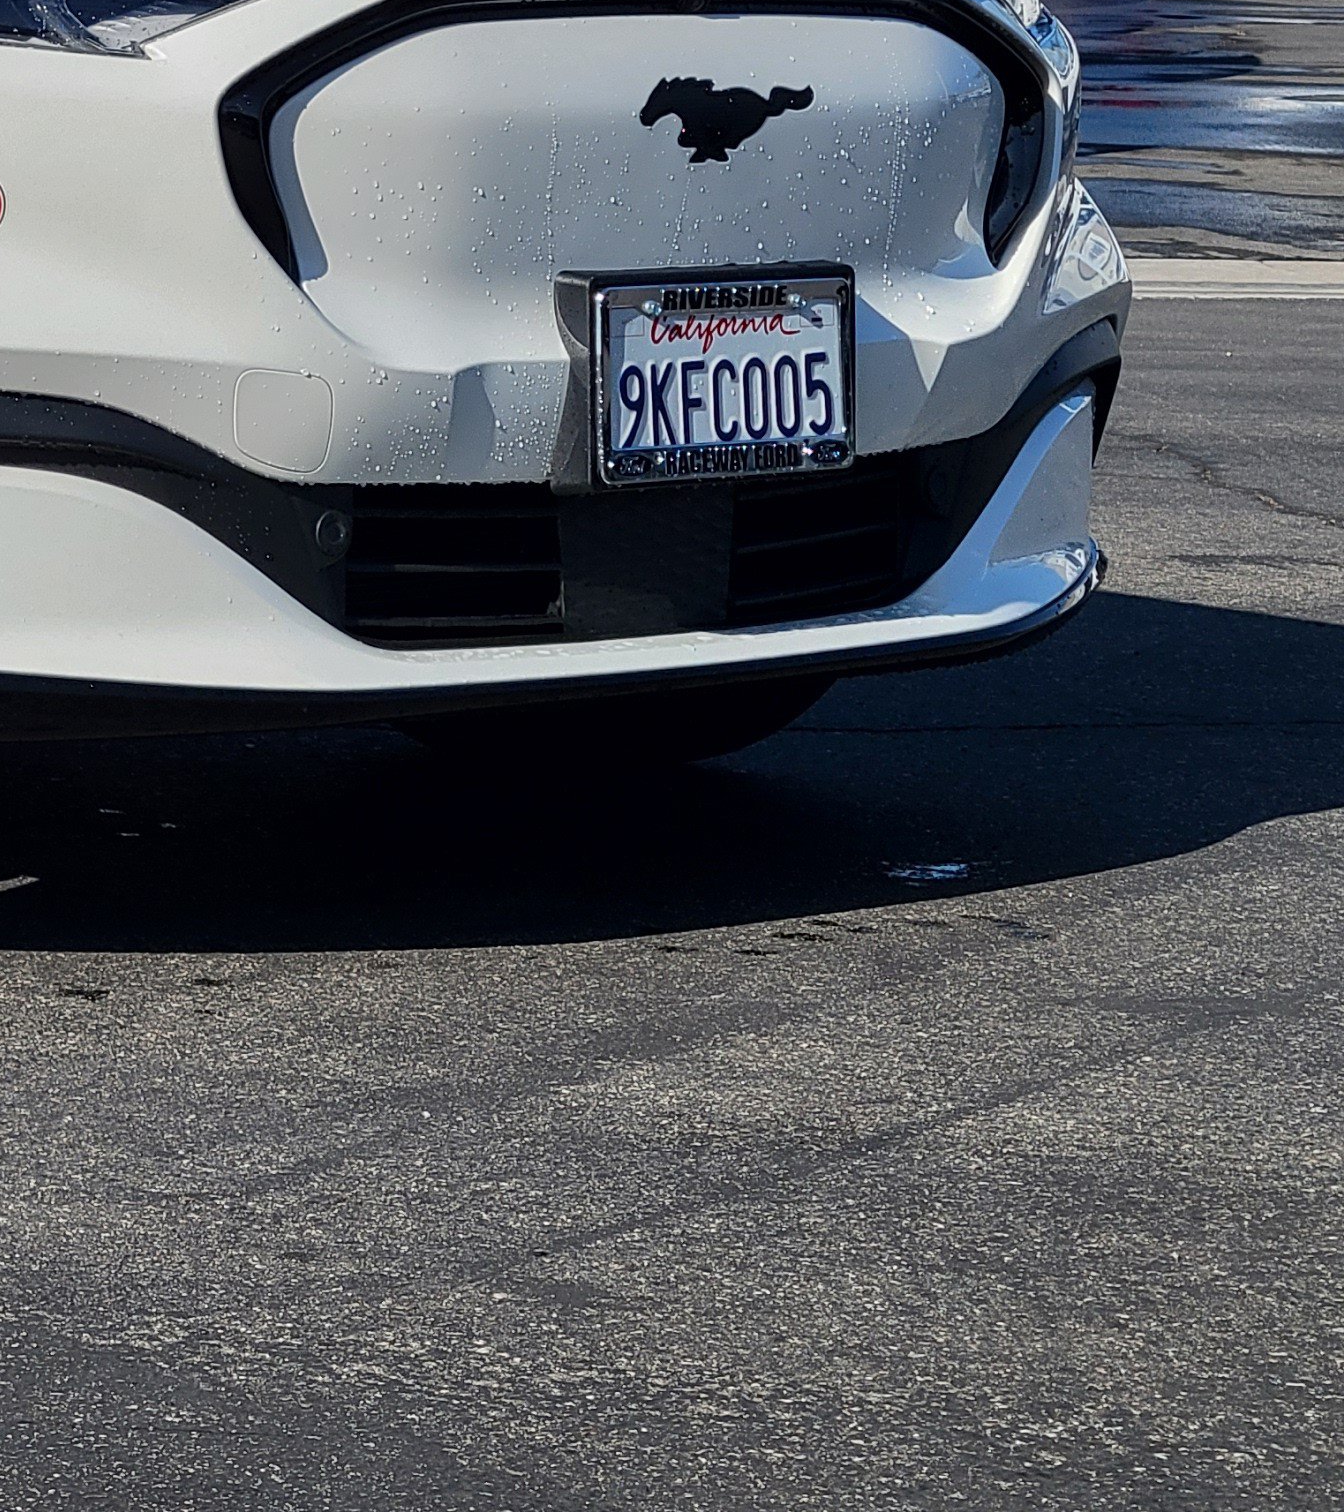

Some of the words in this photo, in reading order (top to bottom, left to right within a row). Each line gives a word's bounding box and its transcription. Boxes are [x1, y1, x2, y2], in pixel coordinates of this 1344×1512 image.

[661, 285, 788, 312] RIVERSIDE
[650, 313, 801, 355] California
[618, 351, 833, 449] 9KFC005
[664, 445, 749, 476] RACEWAY
[754, 443, 799, 470] FORD
